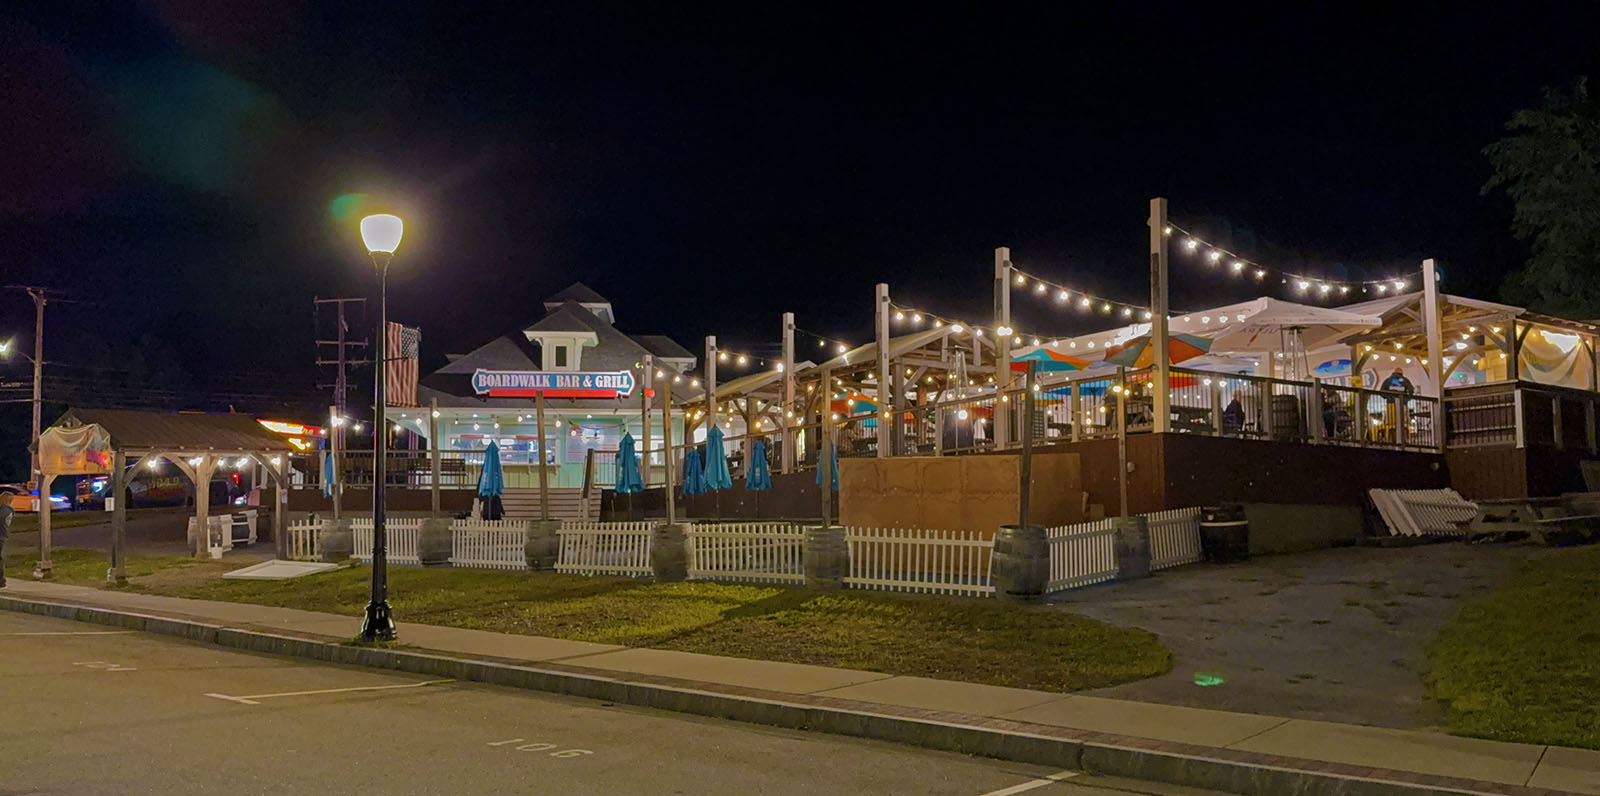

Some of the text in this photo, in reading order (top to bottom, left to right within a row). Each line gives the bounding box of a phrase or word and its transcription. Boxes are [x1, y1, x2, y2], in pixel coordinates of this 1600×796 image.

[478, 374, 630, 389] BOARDWALK BAR & GRILL
[486, 738, 594, 758] 106
